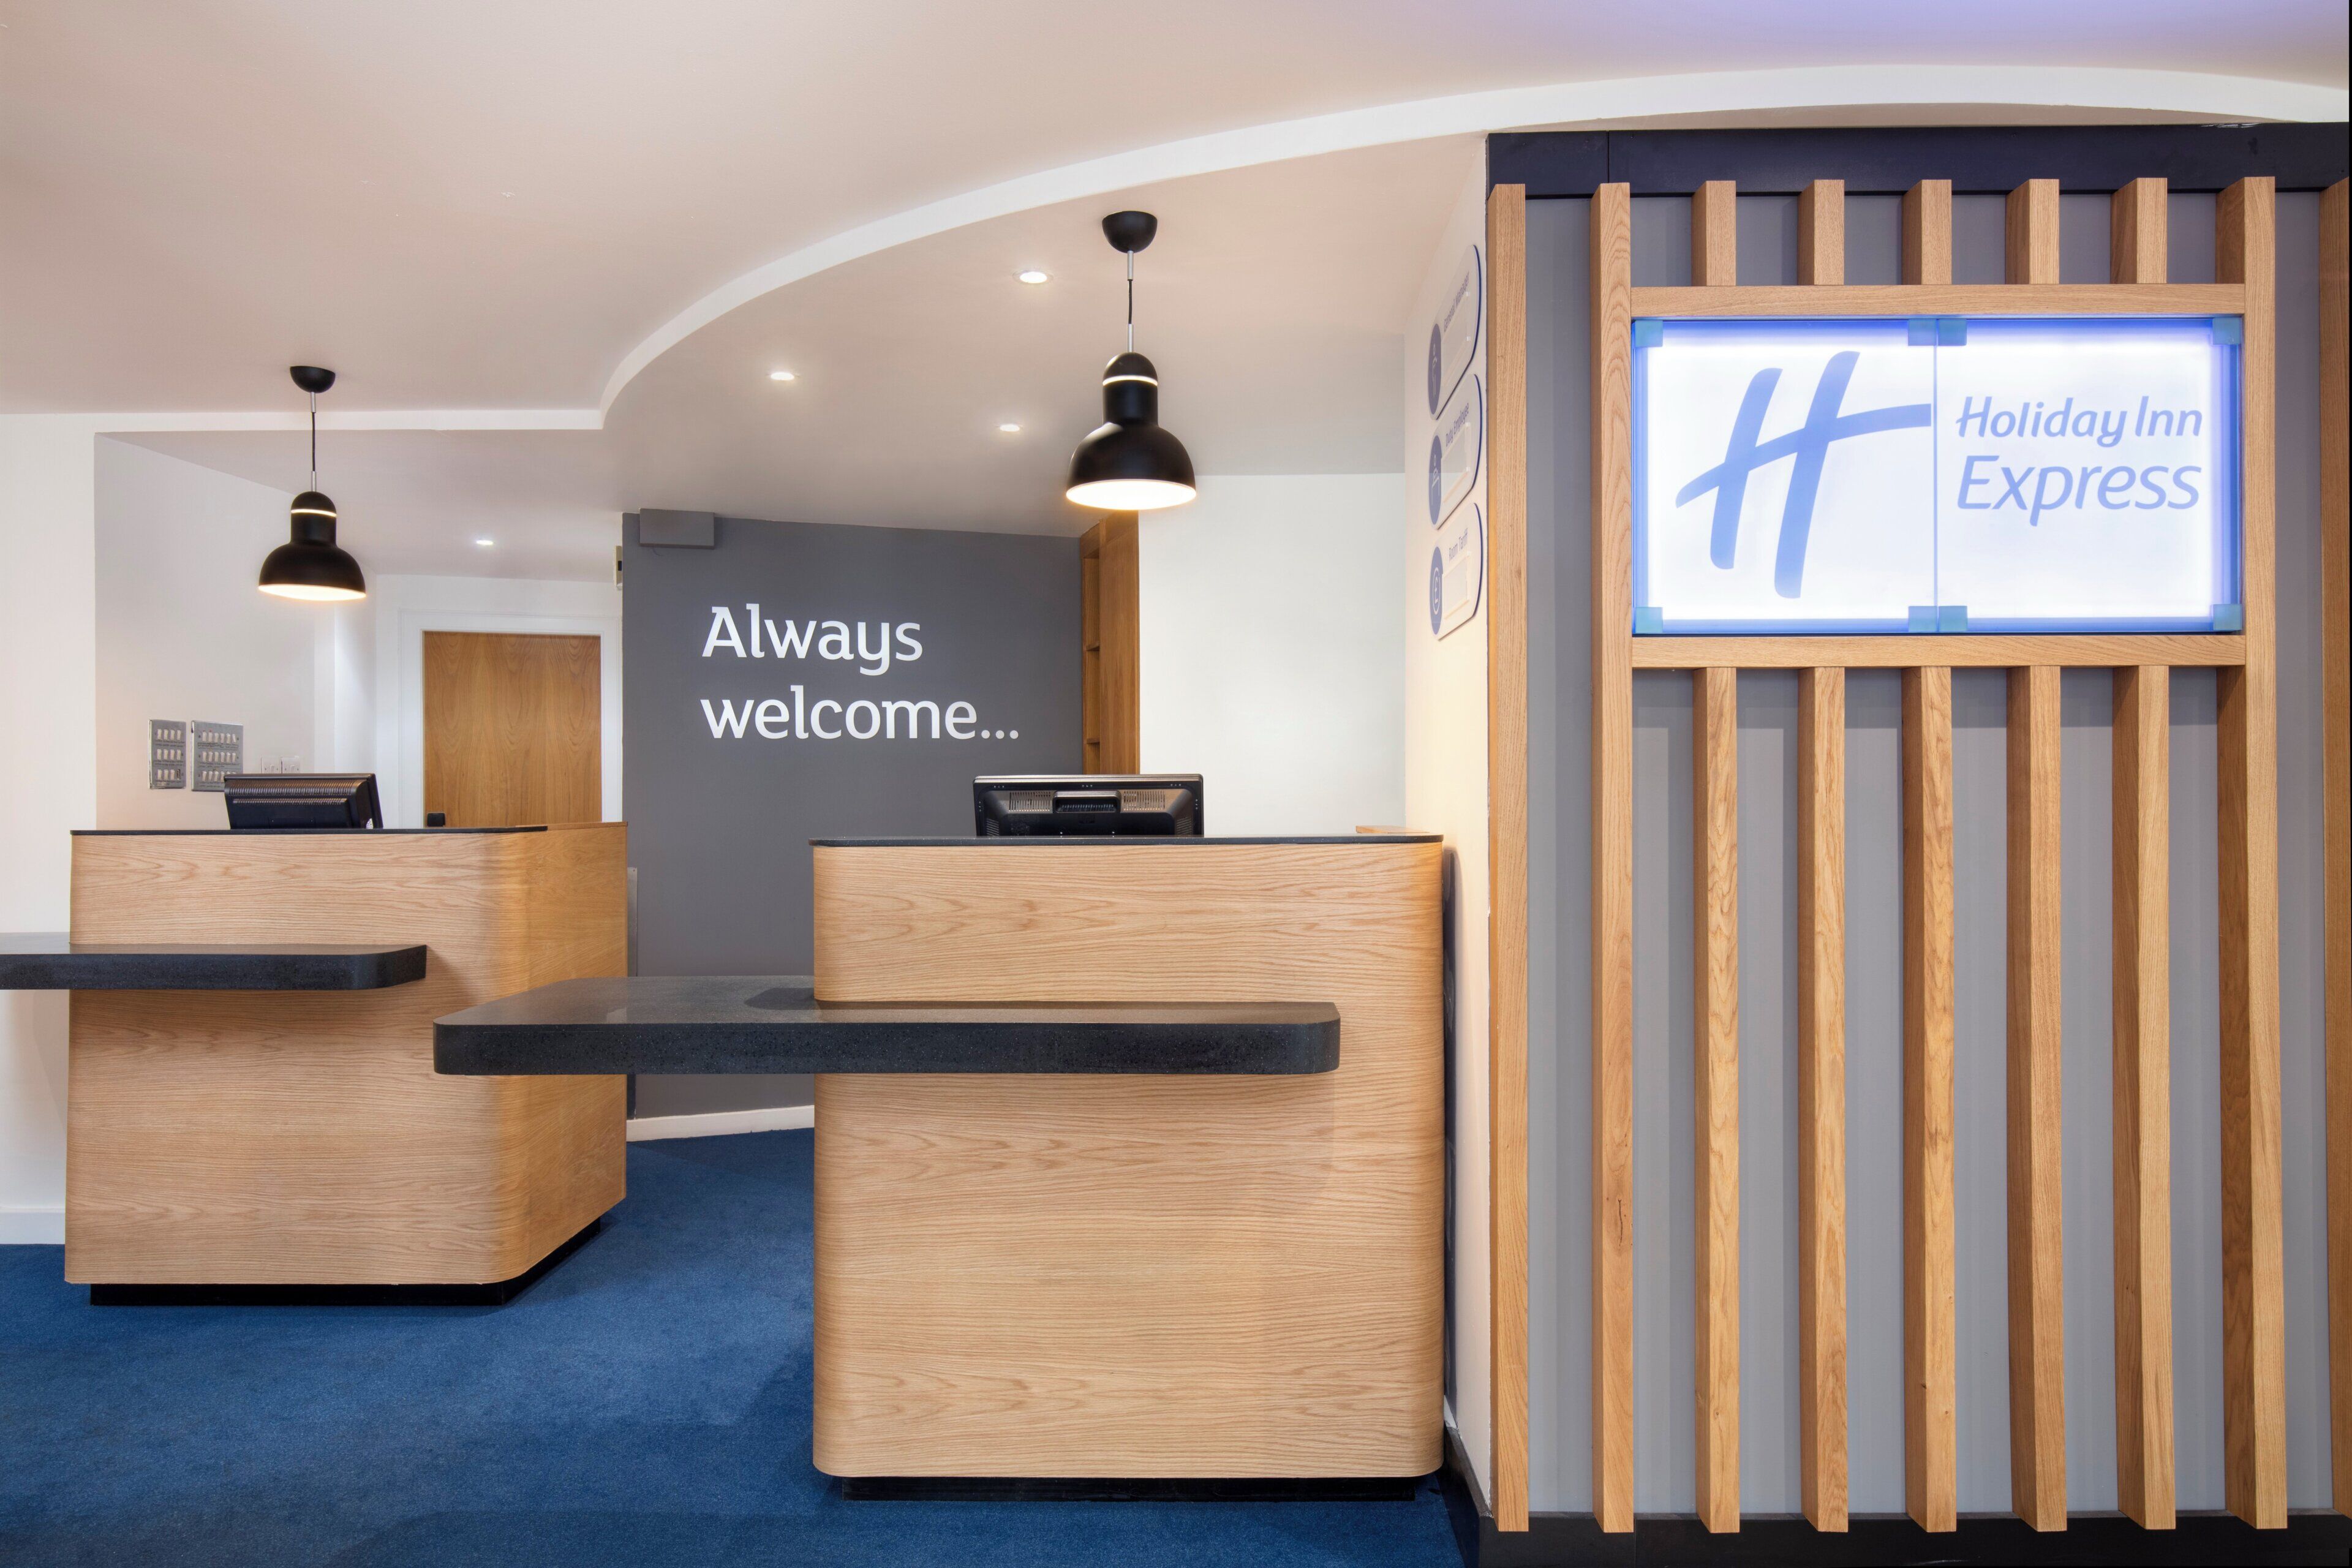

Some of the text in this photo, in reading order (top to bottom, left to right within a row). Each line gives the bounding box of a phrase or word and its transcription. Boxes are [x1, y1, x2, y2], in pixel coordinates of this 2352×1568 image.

[1444, 270, 1469, 333] General Manager
[1453, 402, 1469, 435] Employee
[1955, 395, 2203, 448] Holiday Inn
[1957, 454, 2202, 527] Express
[1449, 527, 1468, 564] Room Tariff
[702, 603, 922, 676] Always
[700, 685, 1019, 740] welcome...
